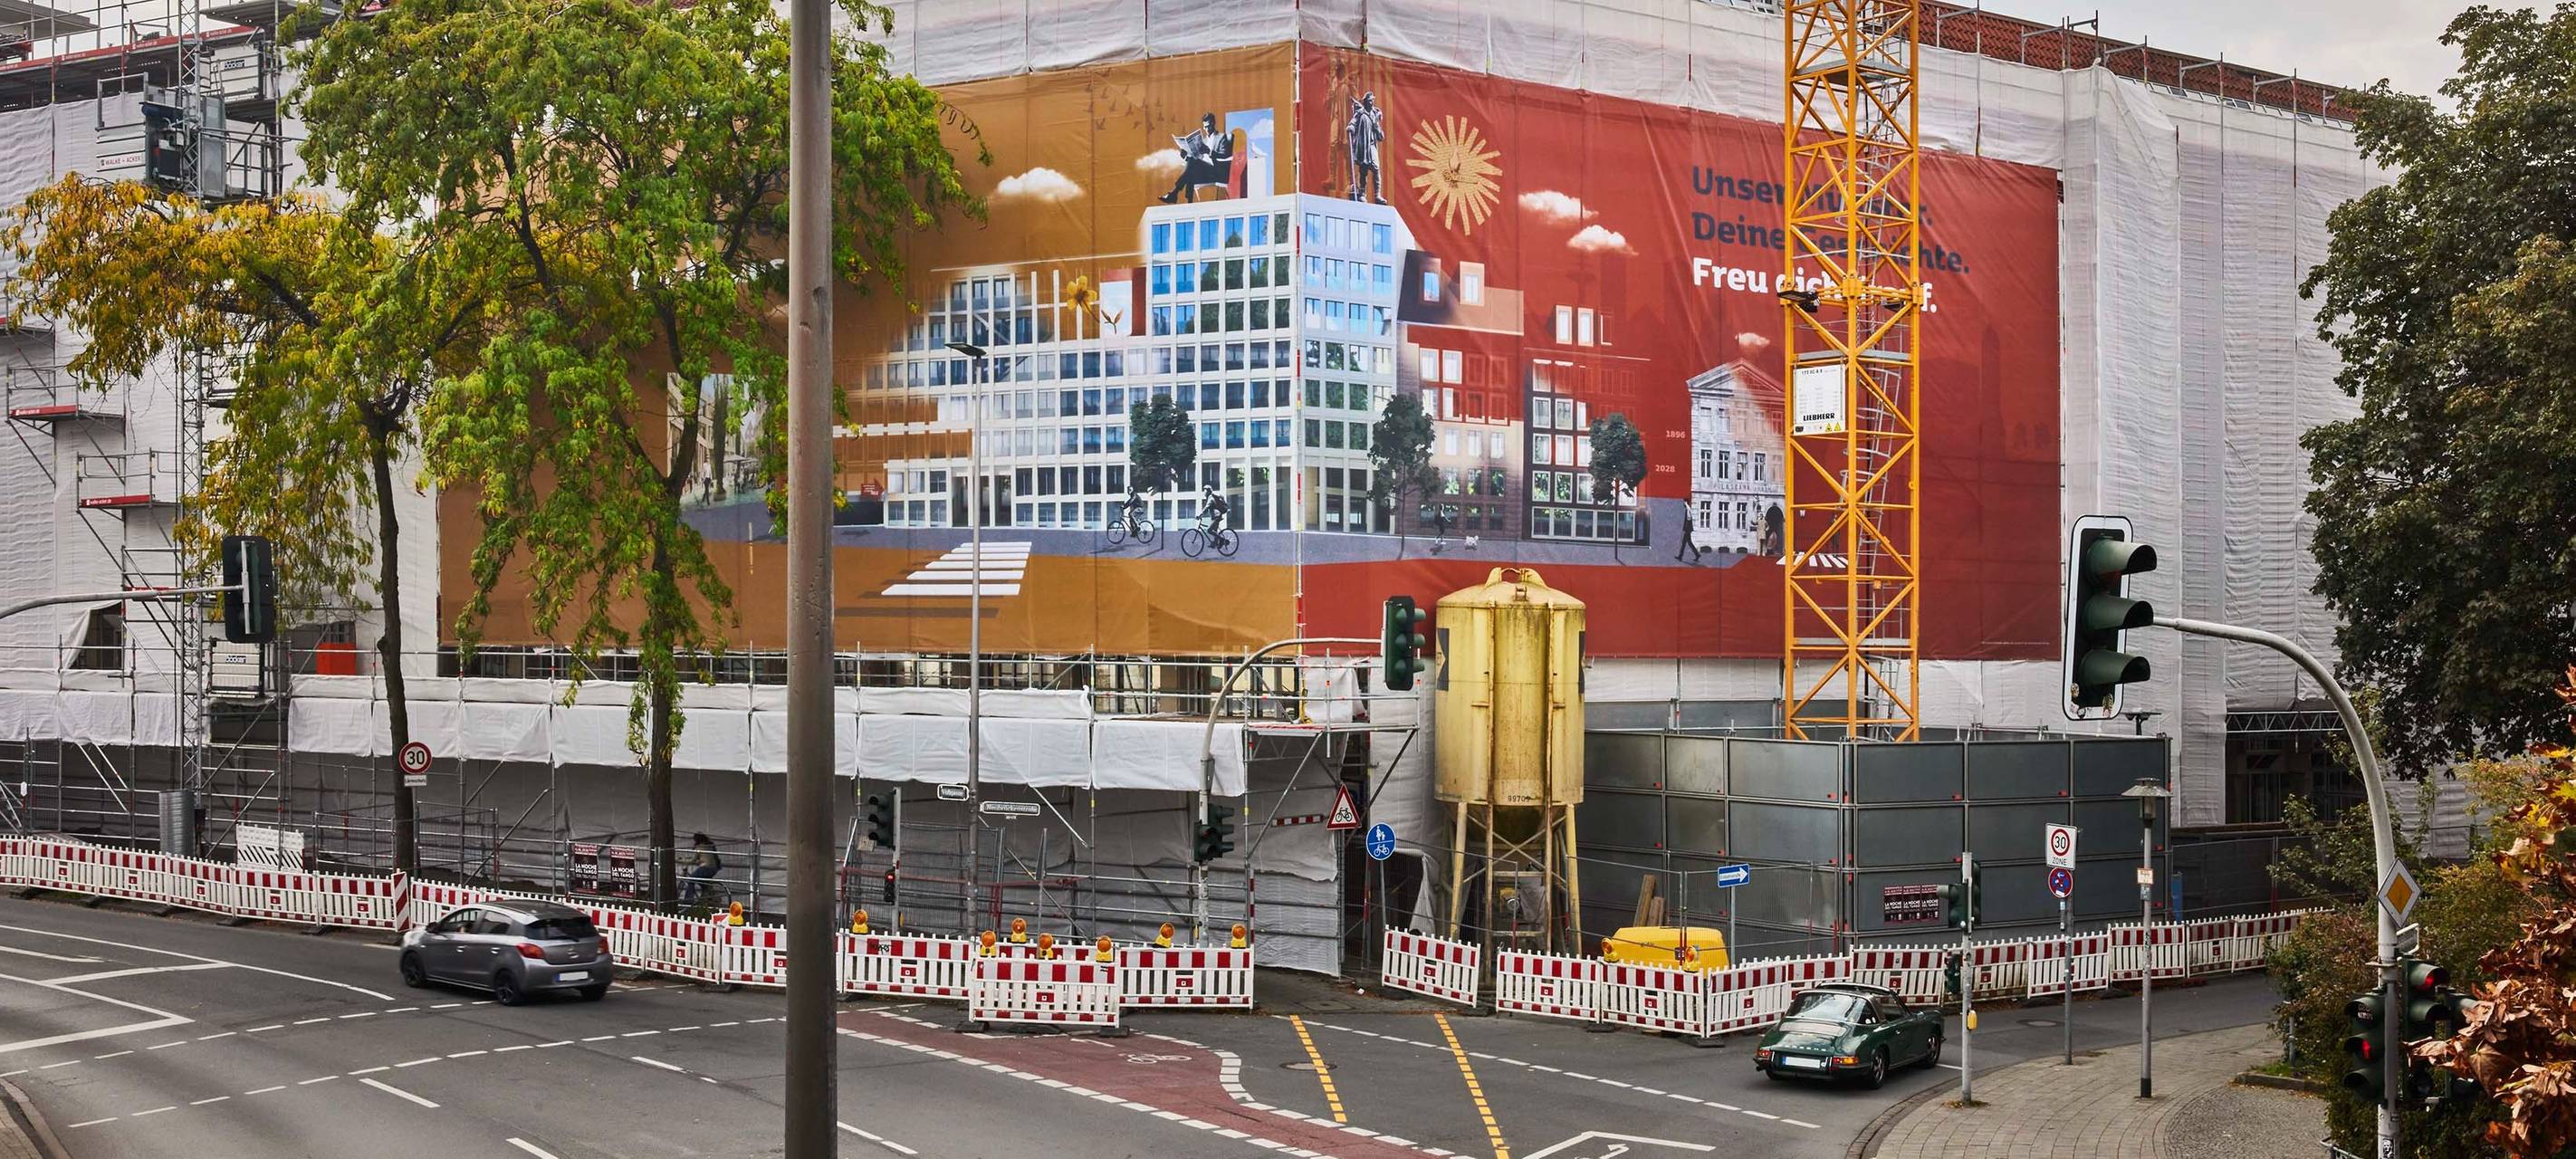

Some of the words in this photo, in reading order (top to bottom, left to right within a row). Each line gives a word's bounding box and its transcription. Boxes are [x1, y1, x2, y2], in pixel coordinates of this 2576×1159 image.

[1693, 166, 1786, 205] Unser
[1691, 211, 1786, 250] Deine
[1795, 225, 1969, 273] Gesichte.
[1693, 257, 1768, 293] Freu
[1803, 412, 1835, 422] LIEBHERR
[1666, 430, 1685, 439] 1896
[1655, 464, 1675, 473] 2028
[407, 751, 425, 765] 30
[2054, 836, 2066, 848] 30
[2052, 857, 2066, 866] ZONE
